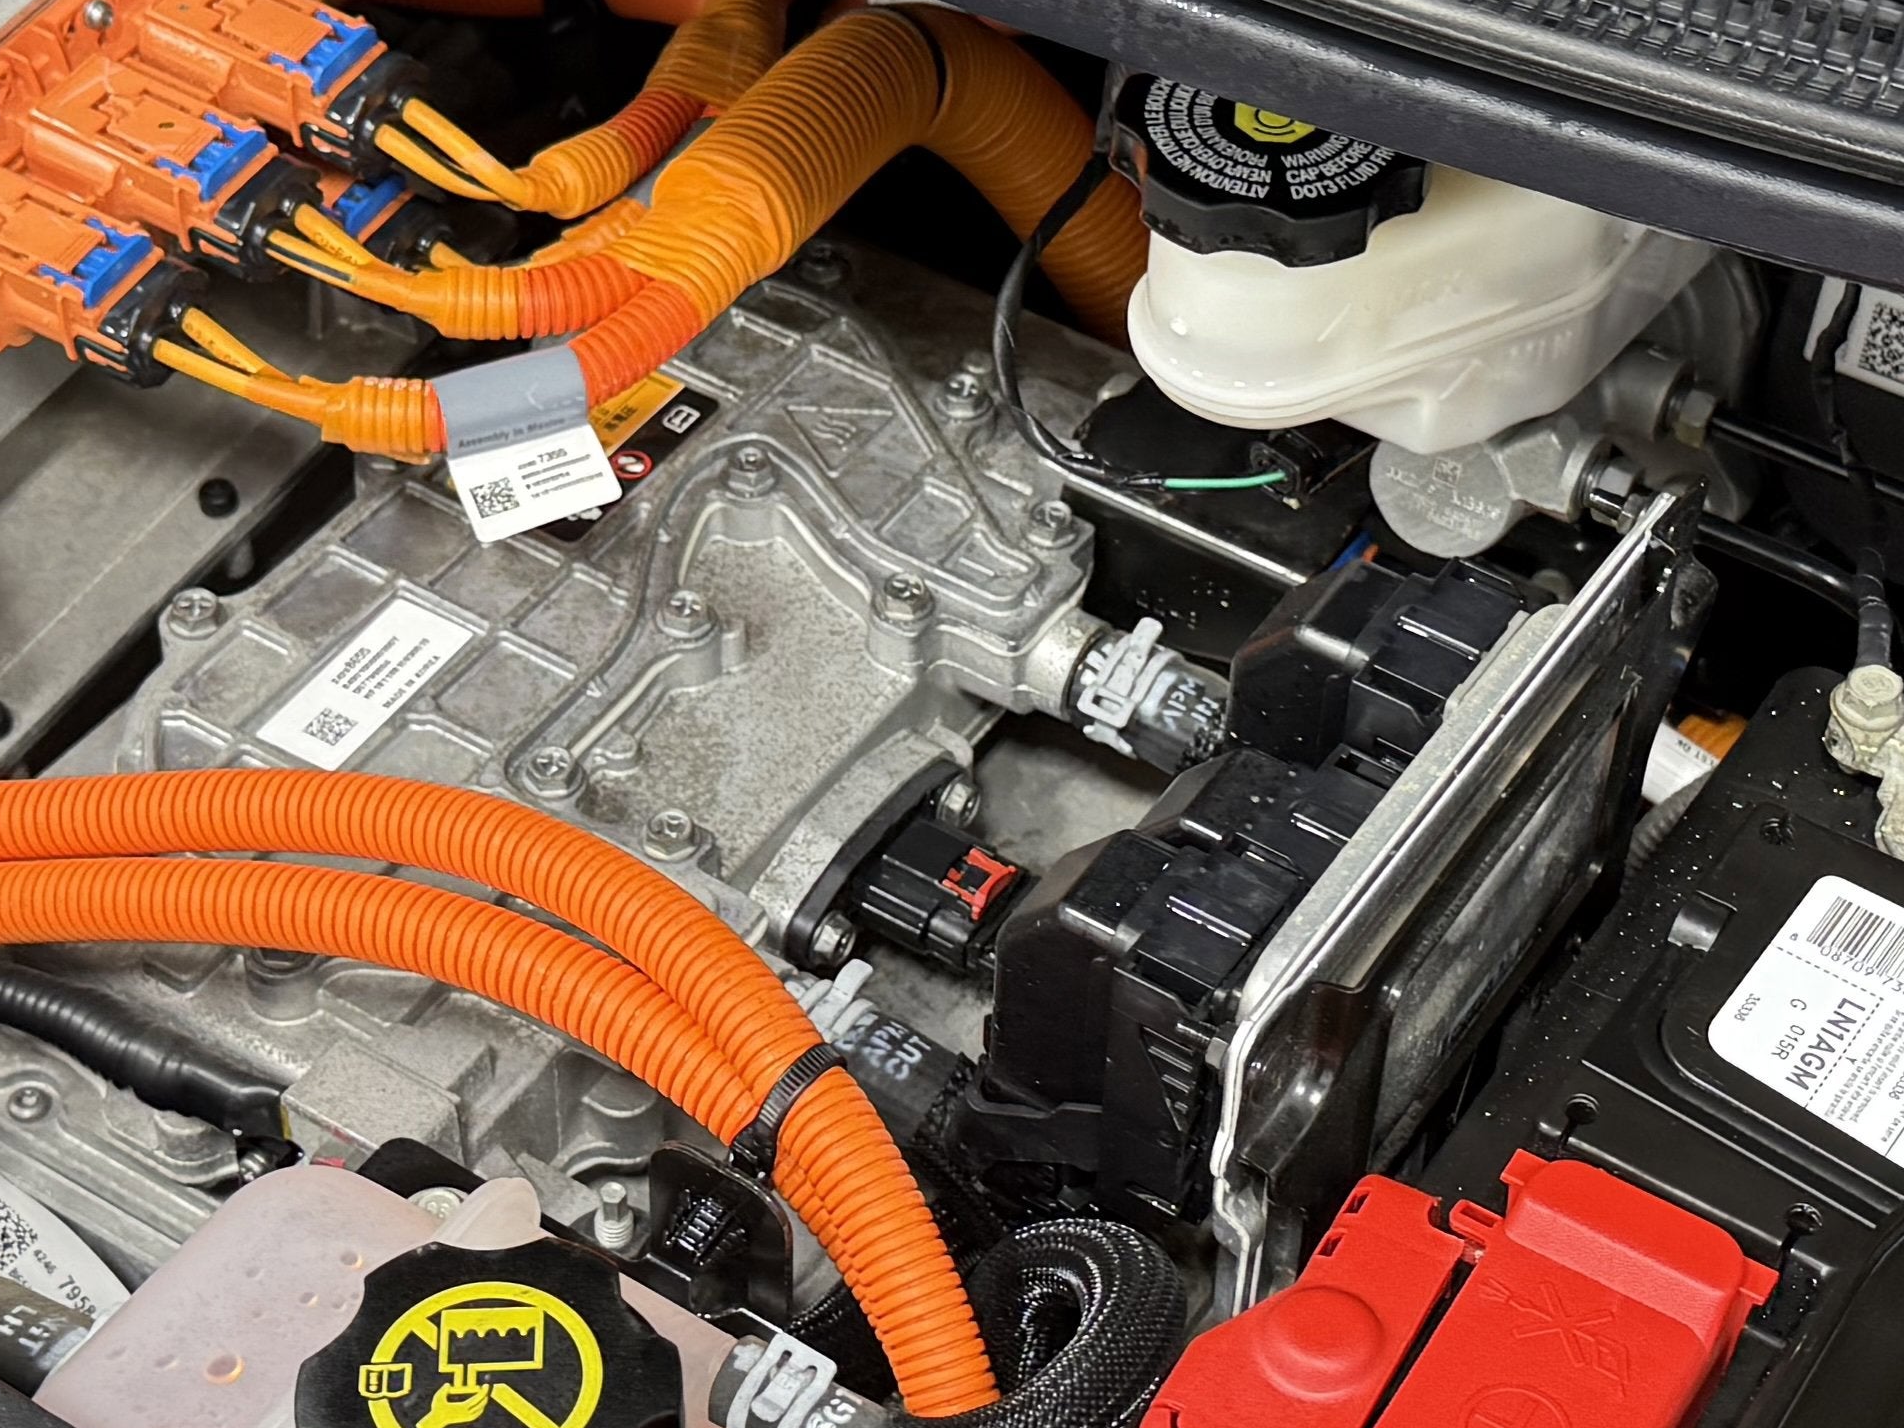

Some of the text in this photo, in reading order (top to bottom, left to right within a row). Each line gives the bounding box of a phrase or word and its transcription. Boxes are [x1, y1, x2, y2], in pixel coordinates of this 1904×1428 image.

[1282, 135, 1349, 168] WARNING
[1286, 142, 1372, 183] CAP BEFORE
[1289, 180, 1337, 199] DOT3
[1337, 163, 1380, 190] FLUID
[457, 414, 565, 453] Assembly in Mexico
[1162, 677, 1204, 732] APM
[1788, 996, 1808, 1012] G
[1770, 1022, 1806, 1061] 015R
[1785, 996, 1866, 1092] LN1AGM
[55, 1272, 97, 1322] 7958
